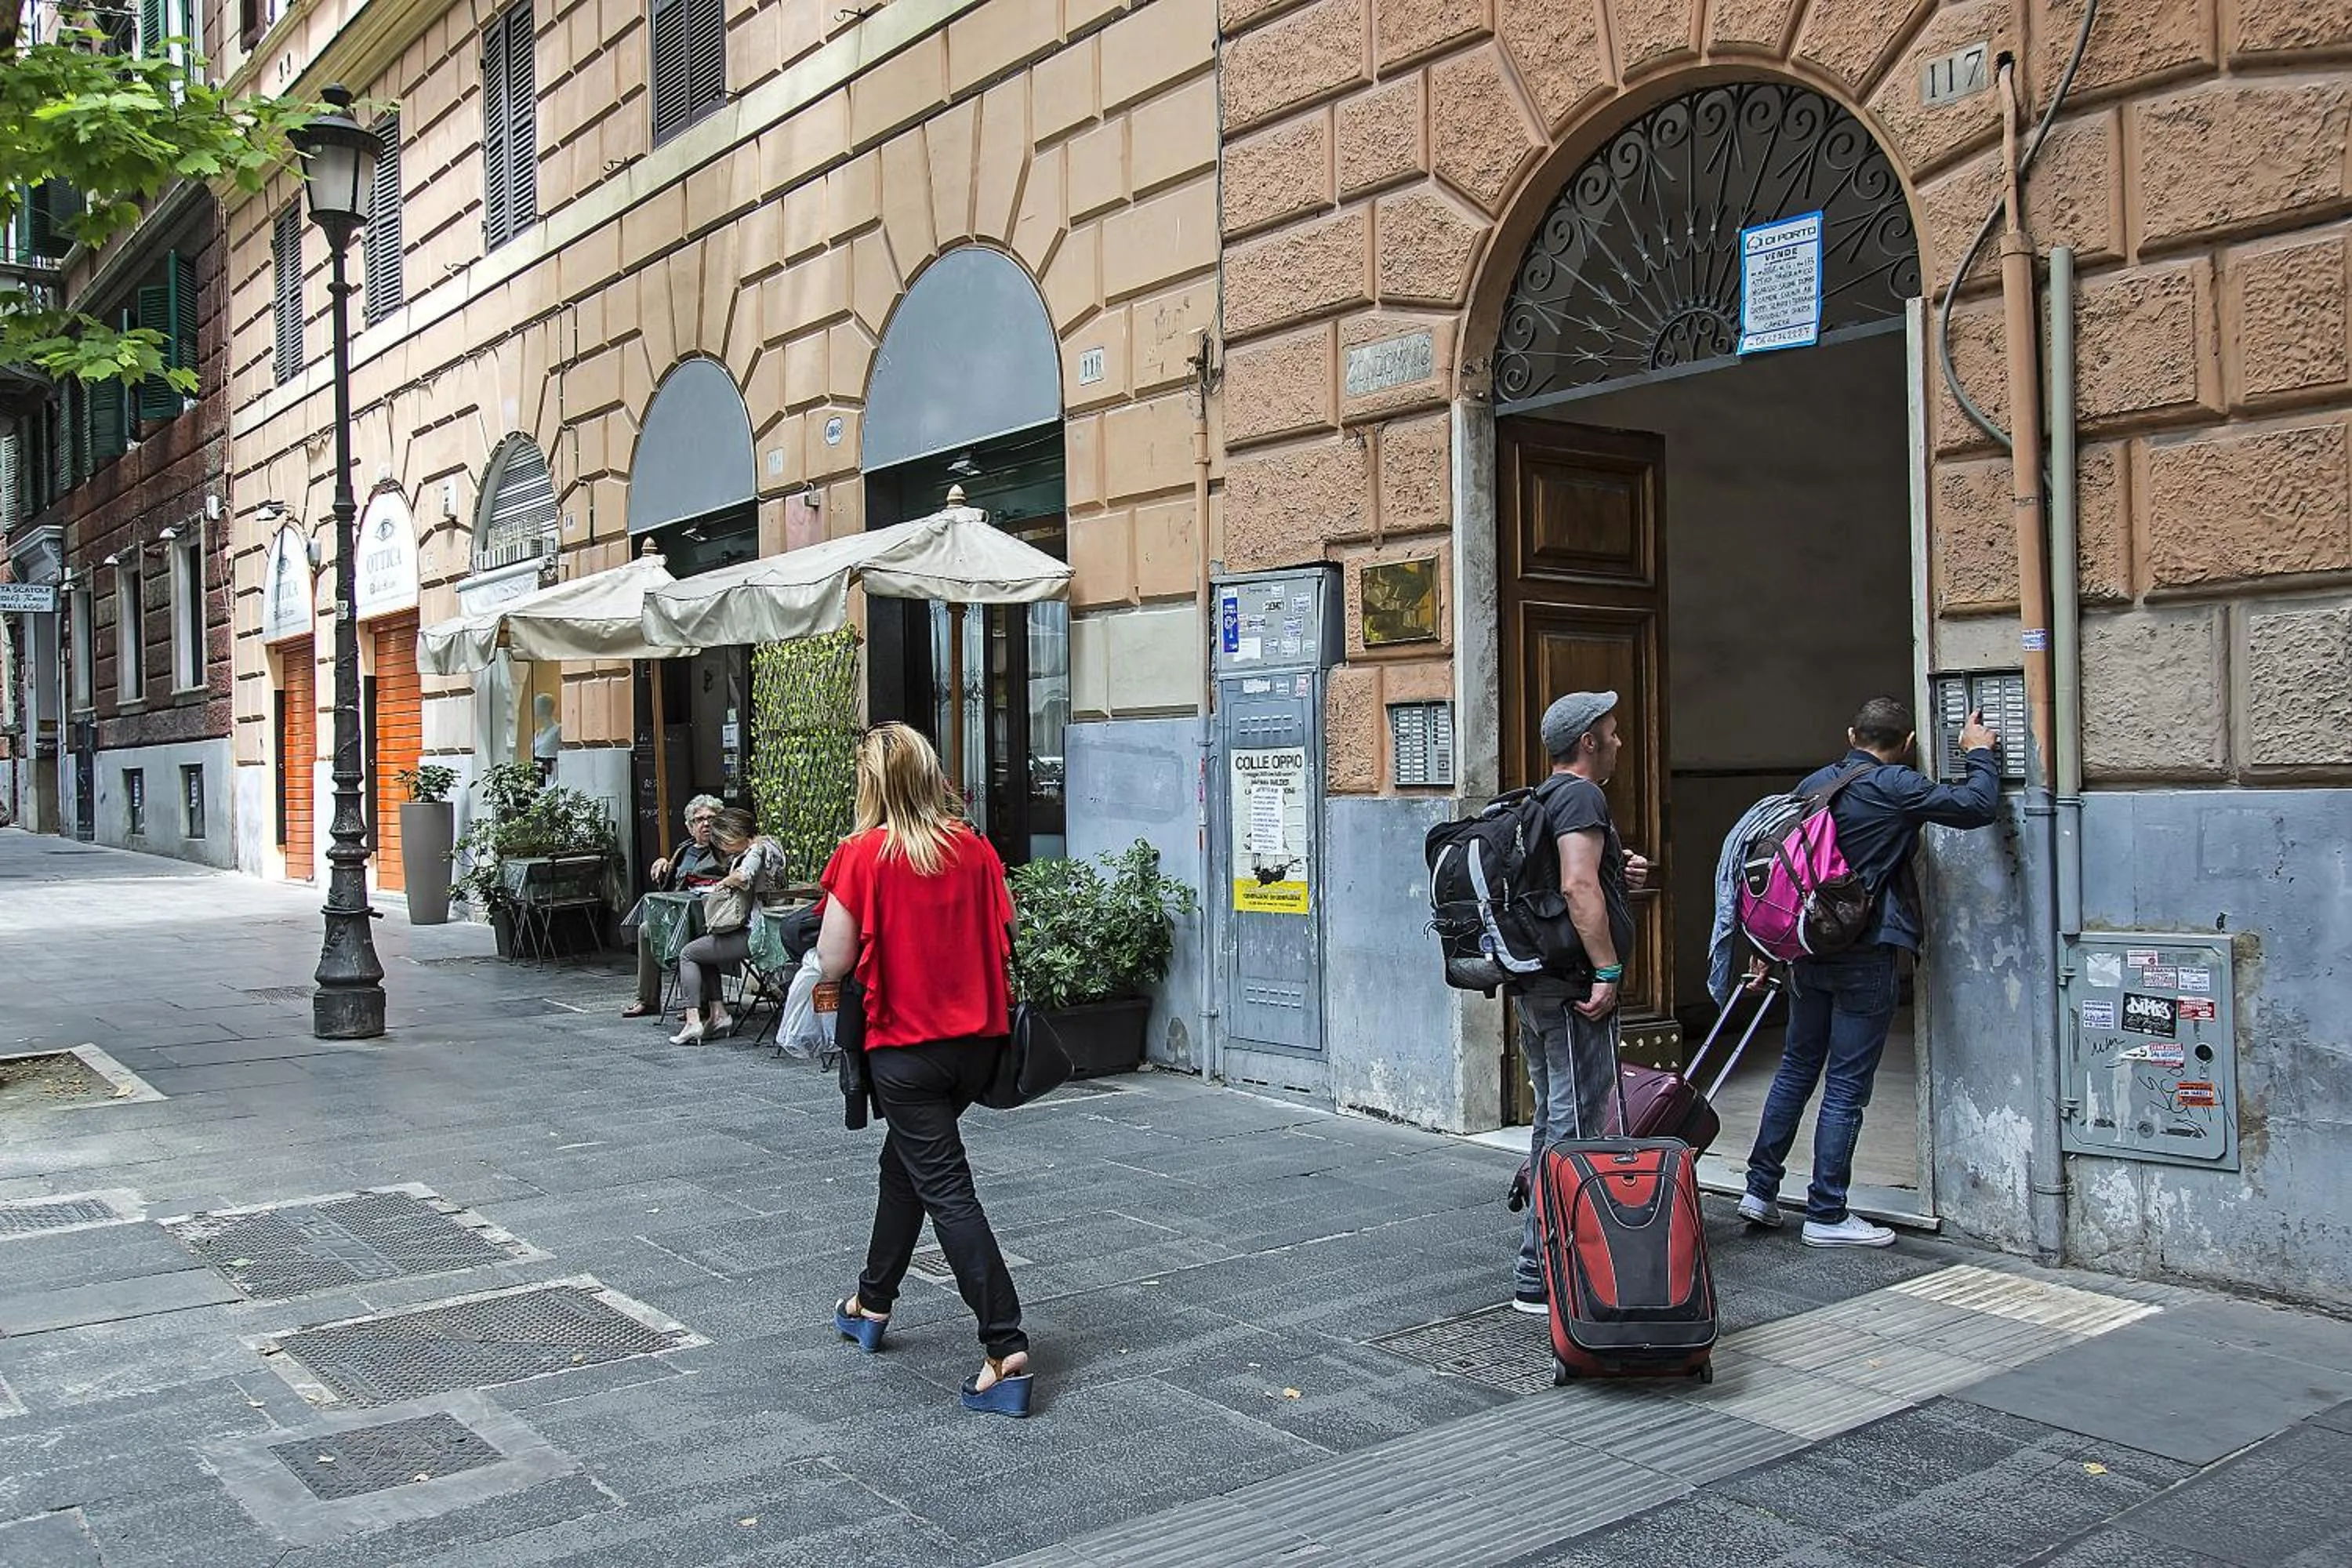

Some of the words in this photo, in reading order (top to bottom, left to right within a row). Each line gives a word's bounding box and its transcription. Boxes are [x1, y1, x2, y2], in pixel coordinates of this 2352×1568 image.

[1930, 49, 1983, 99] 117
[1765, 247, 1798, 261] VENDE
[366, 546, 401, 574] OTTICA
[1236, 755, 1269, 770] COLLE
[1272, 753, 1302, 769] OPPIO
